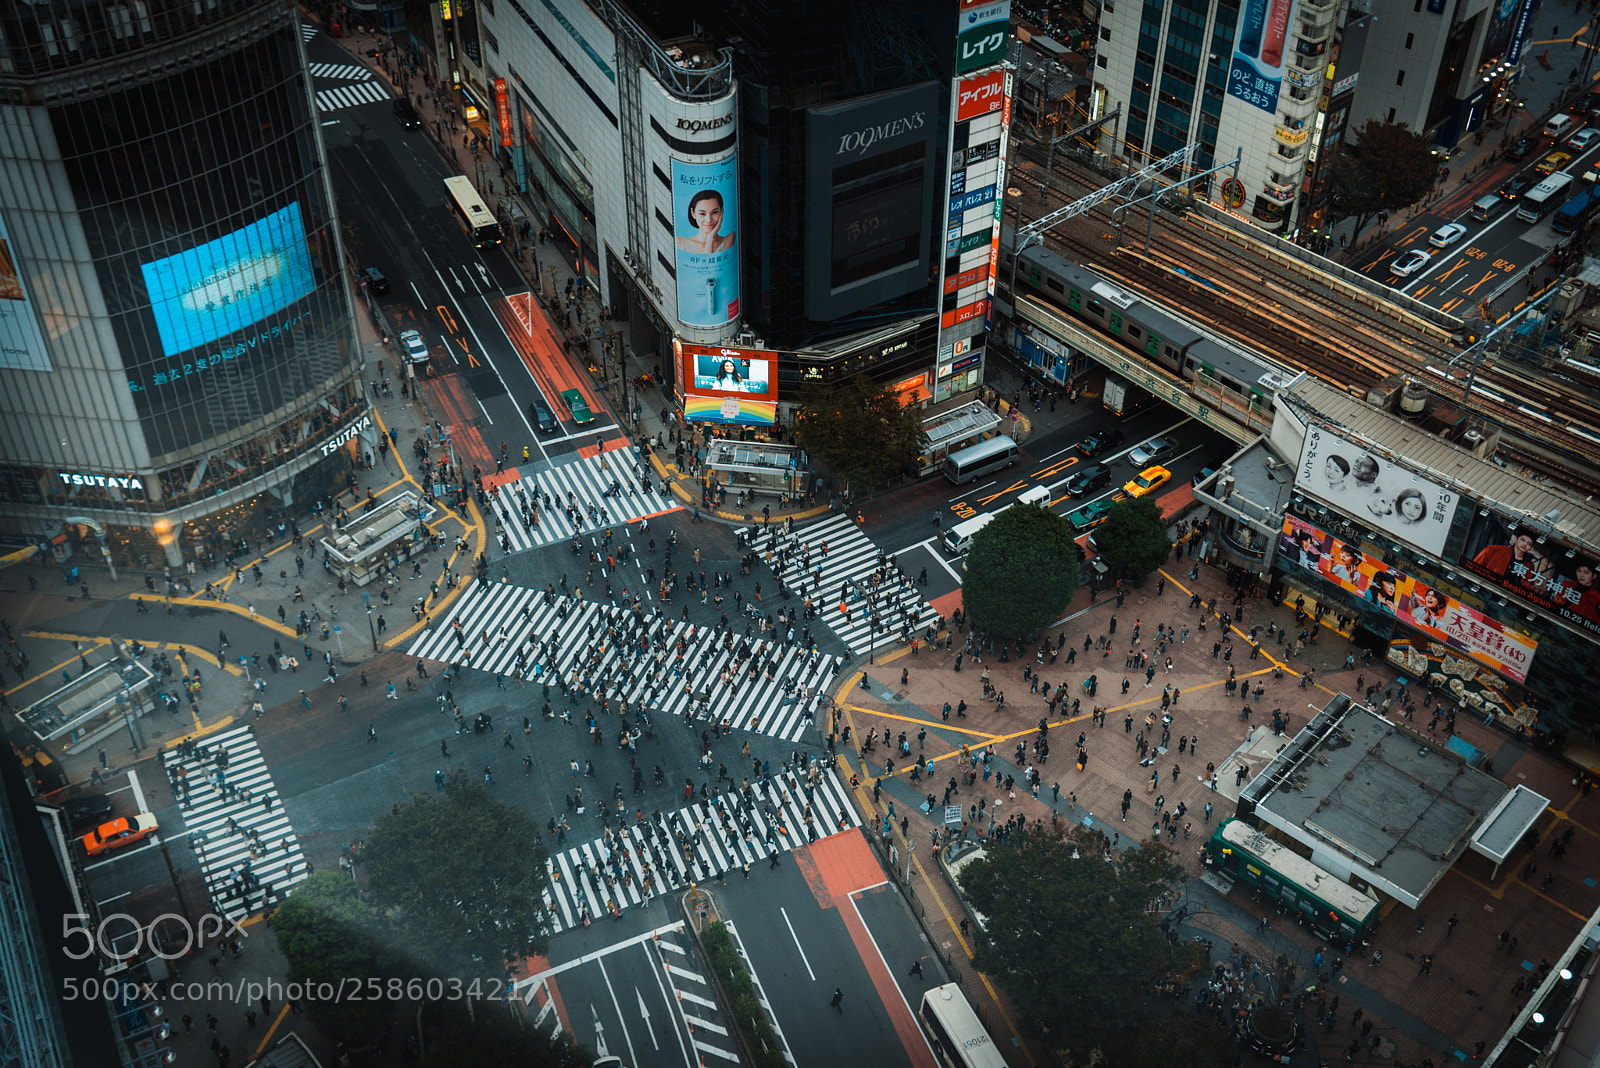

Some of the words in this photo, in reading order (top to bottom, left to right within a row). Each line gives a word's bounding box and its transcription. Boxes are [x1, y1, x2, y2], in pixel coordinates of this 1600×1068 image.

[963, 32, 1004, 59] レイク
[960, 82, 1001, 106] アイフル
[1235, 84, 1269, 107] うるおう
[989, 101, 1001, 110] 8F
[962, 236, 979, 248] レイク
[1464, 246, 1488, 260] 8-20
[1491, 258, 1516, 272] 8-20
[948, 272, 976, 289] アコム
[1119, 362, 1130, 372] JR
[321, 416, 371, 457] TSUTAYA
[59, 473, 142, 489] TSUTAYA
[950, 500, 977, 519] 8-20
[1433, 494, 1451, 523] 10年間
[1293, 503, 1318, 521] JR
[1319, 514, 1359, 540] 渋谷駅
[1511, 561, 1582, 605] 東方神起
[1560, 608, 1582, 624] 10.25
[963, 1035, 987, 1050] 21051
